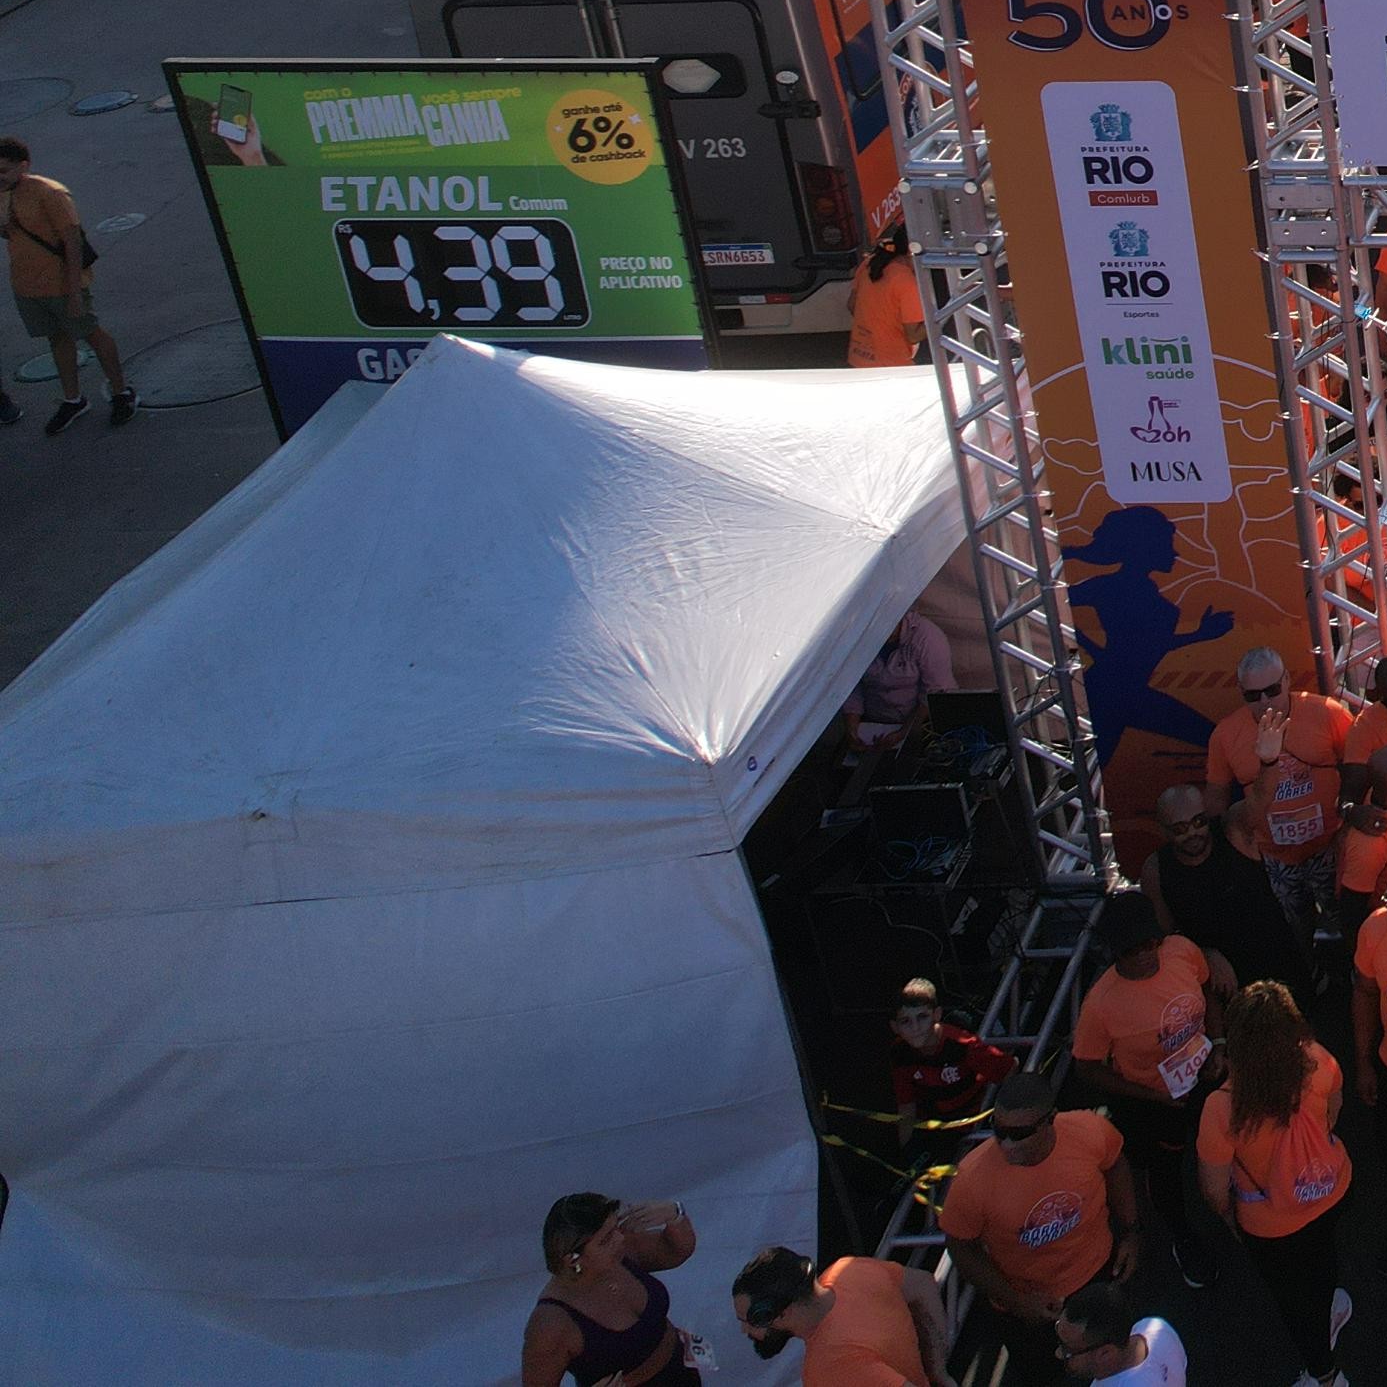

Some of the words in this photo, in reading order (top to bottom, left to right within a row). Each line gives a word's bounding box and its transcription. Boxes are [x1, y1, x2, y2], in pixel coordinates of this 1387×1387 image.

[305, 93, 425, 144] PREMMIA
[562, 104, 600, 119] ganhe
[602, 101, 624, 114] até
[568, 116, 635, 154] 6%
[571, 153, 587, 164] de
[588, 149, 646, 163] cashback
[677, 139, 694, 159] V
[702, 137, 747, 159] 263
[1080, 145, 1150, 153] PREFEITURA
[1082, 155, 1154, 185] RIO
[320, 175, 504, 212] ETANOL
[508, 195, 568, 211] Comum
[1097, 193, 1151, 205] Comlurb
[880, 190, 901, 219] 263
[350, 225, 565, 322] 4,39
[600, 257, 647, 273] PREÇO
[650, 256, 673, 270] NO
[600, 275, 683, 289] APLICATIVO
[1101, 270, 1171, 299] RIO
[1123, 311, 1160, 319] Esportes
[1101, 335, 1193, 365] klini
[1146, 366, 1195, 380] saúde
[1130, 461, 1203, 482] MUSA
[1276, 820, 1318, 839] 1855
